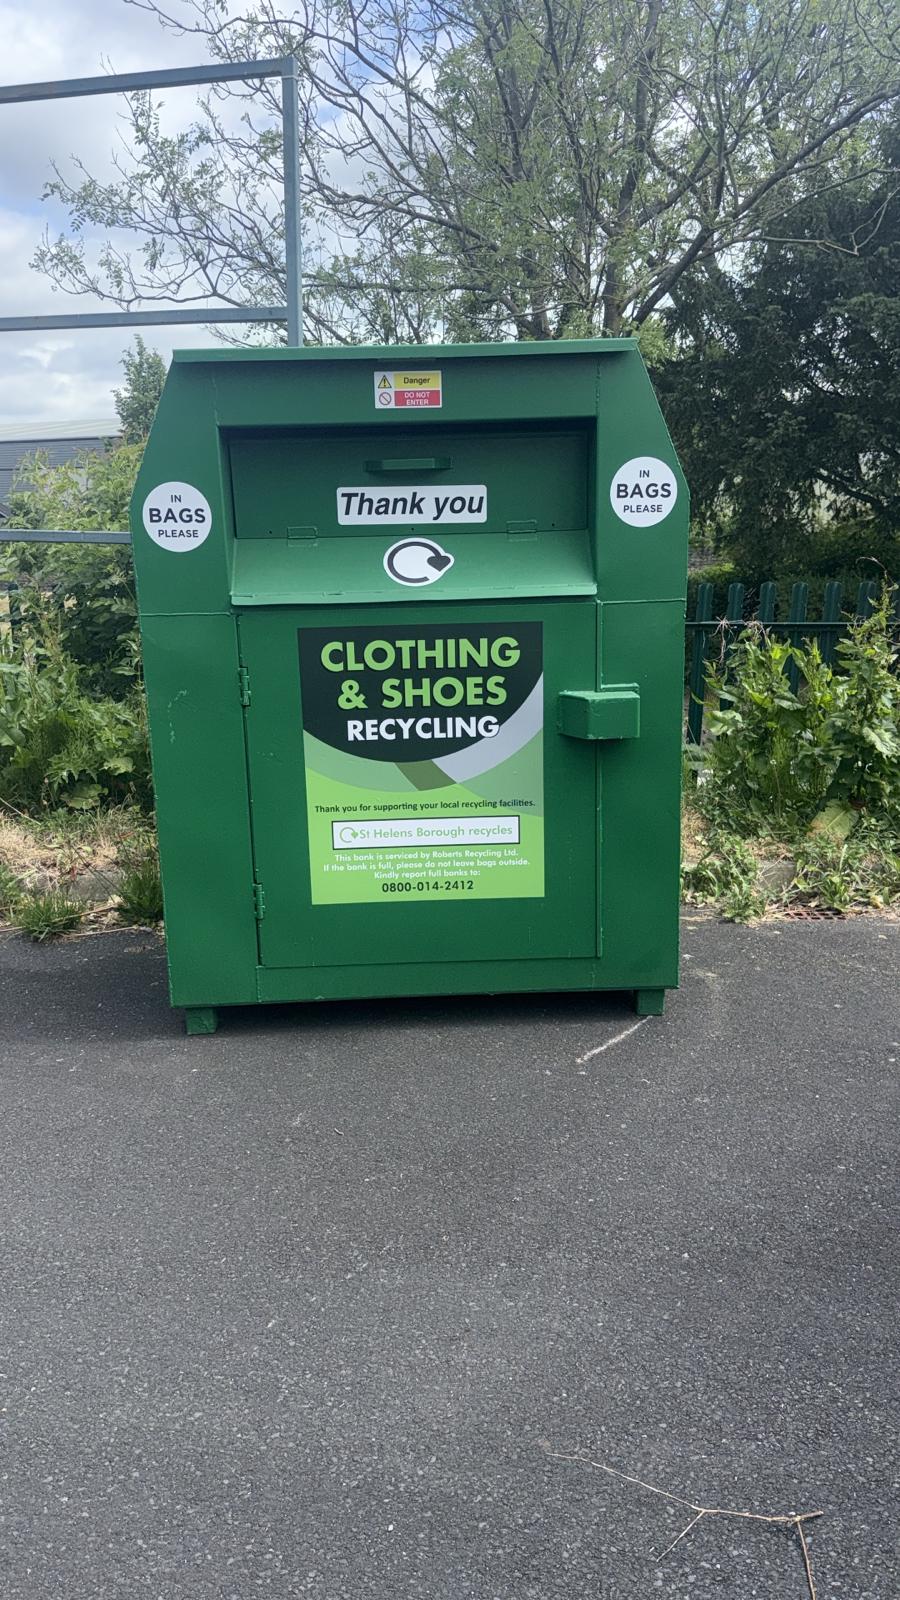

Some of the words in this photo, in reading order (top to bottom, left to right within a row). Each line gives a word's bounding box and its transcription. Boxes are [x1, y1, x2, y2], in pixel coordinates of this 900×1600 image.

[404, 376, 430, 385] Danger
[640, 470, 650, 478] IN
[616, 482, 672, 498] BAGS
[170, 494, 182, 503] IN
[341, 492, 426, 516] Thank
[432, 496, 484, 520] you
[624, 504, 663, 513] PLEASE
[149, 508, 206, 524] BAGS
[158, 530, 199, 538] PLEASE
[320, 636, 520, 673] CLOTHING
[337, 679, 368, 710] &
[382, 675, 507, 709] SHOES
[347, 715, 500, 741] RECYCLING
[315, 804, 340, 813] Thank
[374, 802, 418, 812] supporting
[461, 800, 498, 809] recycling
[360, 829, 370, 839] St
[374, 828, 412, 838] Helens
[416, 826, 464, 838] Borough
[469, 825, 512, 837] recycles
[420, 852, 430, 860] by
[465, 849, 502, 858] Recycling
[347, 863, 367, 871] bank
[378, 862, 394, 870] full,
[396, 861, 422, 870] please
[477, 859, 496, 868] bags
[374, 871, 400, 879] Kindly
[402, 871, 426, 879] report
[382, 880, 474, 892] 0800-014-2412
